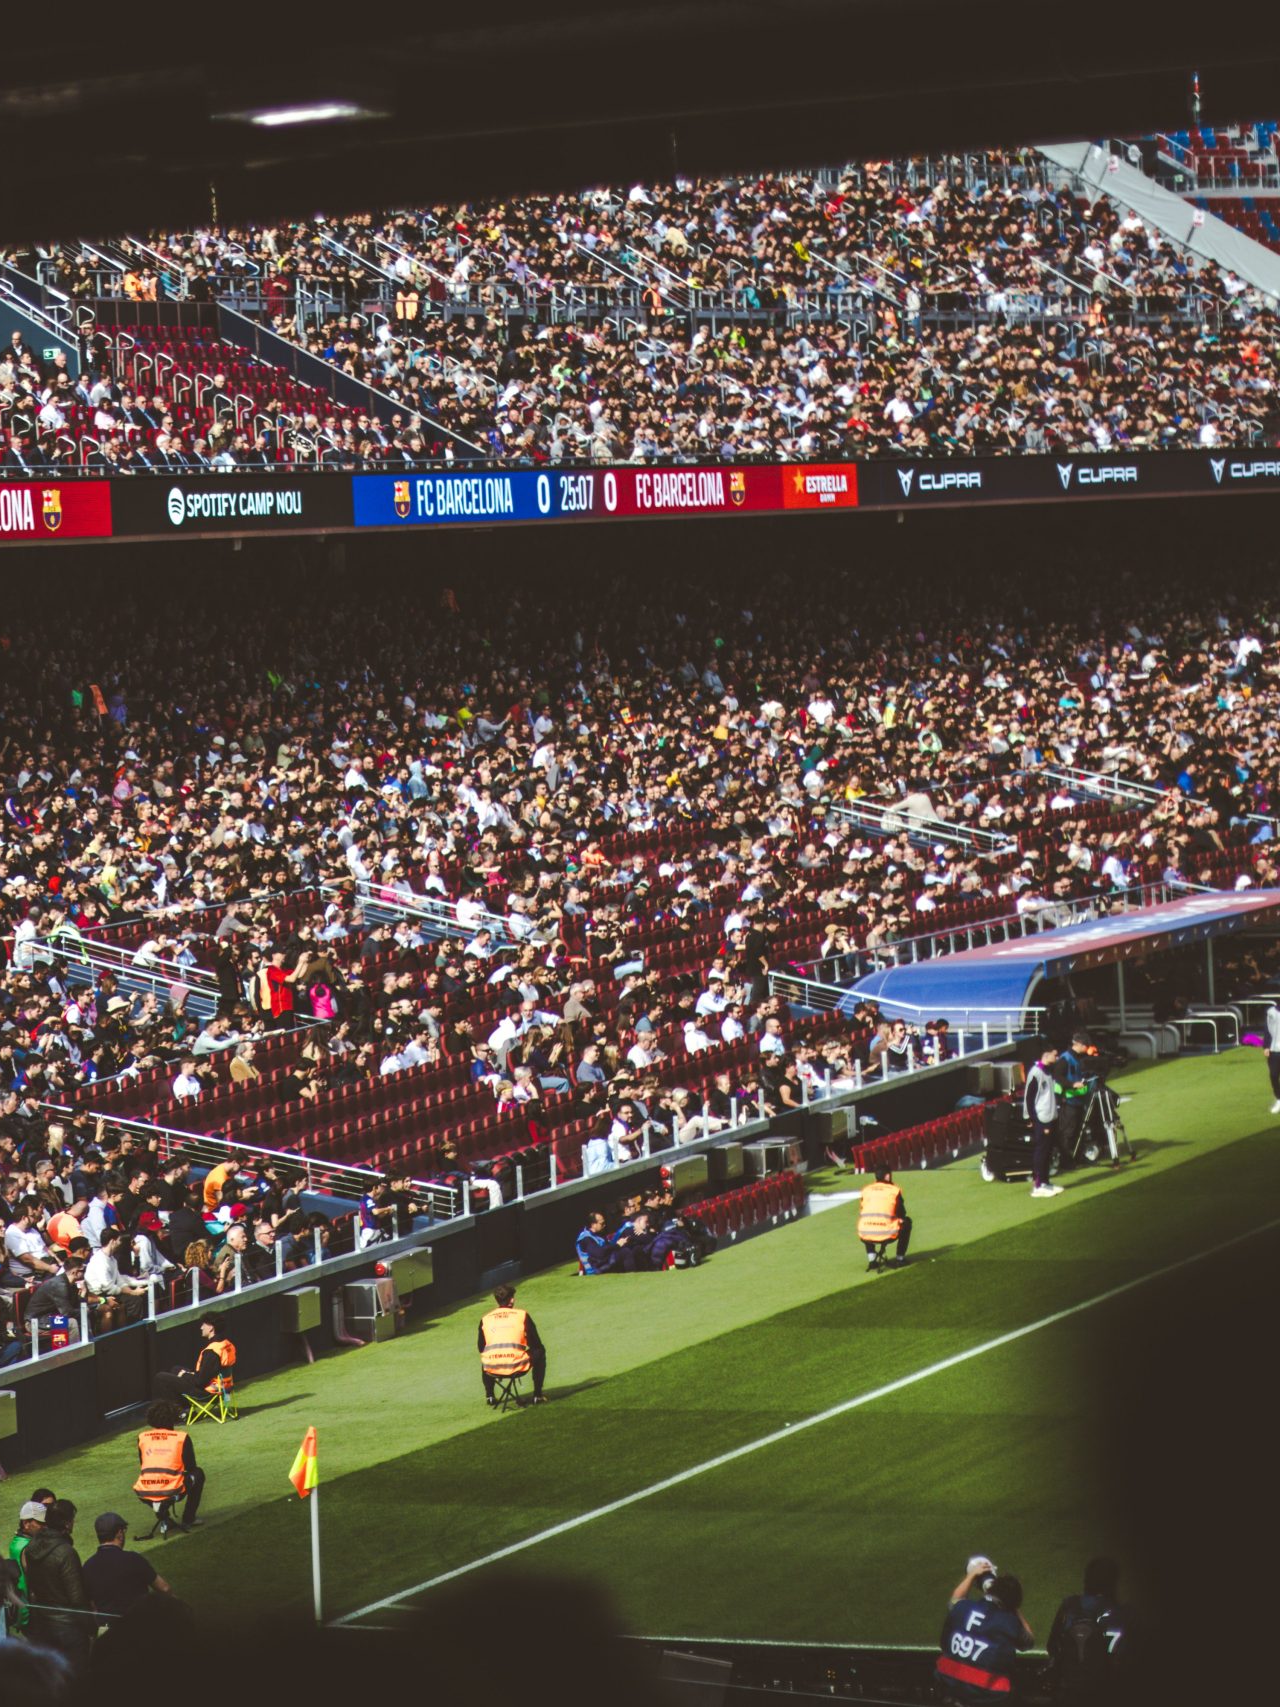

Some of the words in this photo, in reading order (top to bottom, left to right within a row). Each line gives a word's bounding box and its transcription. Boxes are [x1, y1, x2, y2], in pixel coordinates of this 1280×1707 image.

[806, 475, 848, 494] ESTRELLA
[919, 472, 981, 490] CUPRA
[1078, 466, 1138, 484] CUPRA
[186, 493, 237, 518] SPOTIFY
[238, 492, 274, 516] CAMP
[275, 490, 302, 514] NOU
[416, 480, 434, 516] FC
[435, 478, 514, 515] BARCELONA
[537, 475, 551, 514] 0
[559, 475, 594, 511] 25:07
[604, 473, 618, 512] 0
[635, 474, 653, 508] FC
[654, 472, 725, 507] BARCELONA
[965, 1610, 986, 1632] F
[951, 1631, 989, 1662] 697
[1105, 1631, 1122, 1653] 7
